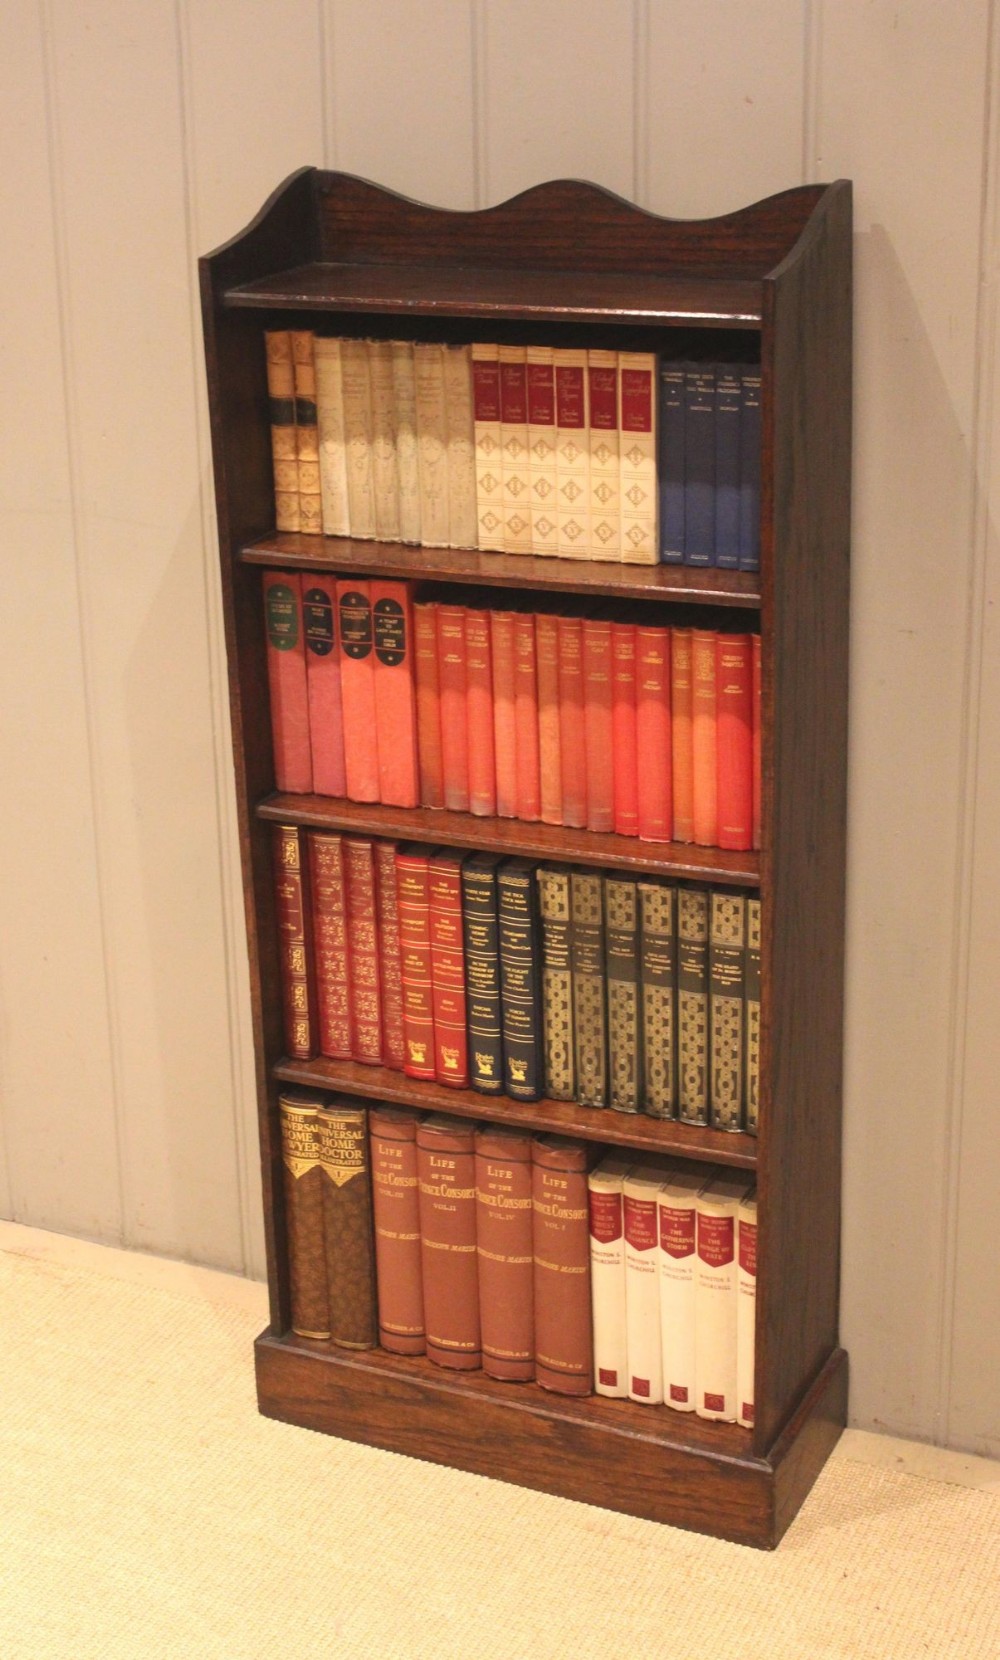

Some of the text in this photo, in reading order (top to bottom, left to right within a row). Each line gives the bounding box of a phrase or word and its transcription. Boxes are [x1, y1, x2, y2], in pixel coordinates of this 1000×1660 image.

[288, 1113, 304, 1123] THE
[327, 1121, 346, 1130] THE
[322, 1136, 356, 1150] HOME
[378, 1144, 402, 1157] LIFE
[429, 1156, 455, 1169] LIFE
[487, 1166, 513, 1179] LIFE
[388, 1172, 418, 1187] CONSO
[543, 1174, 568, 1189] LIFE
